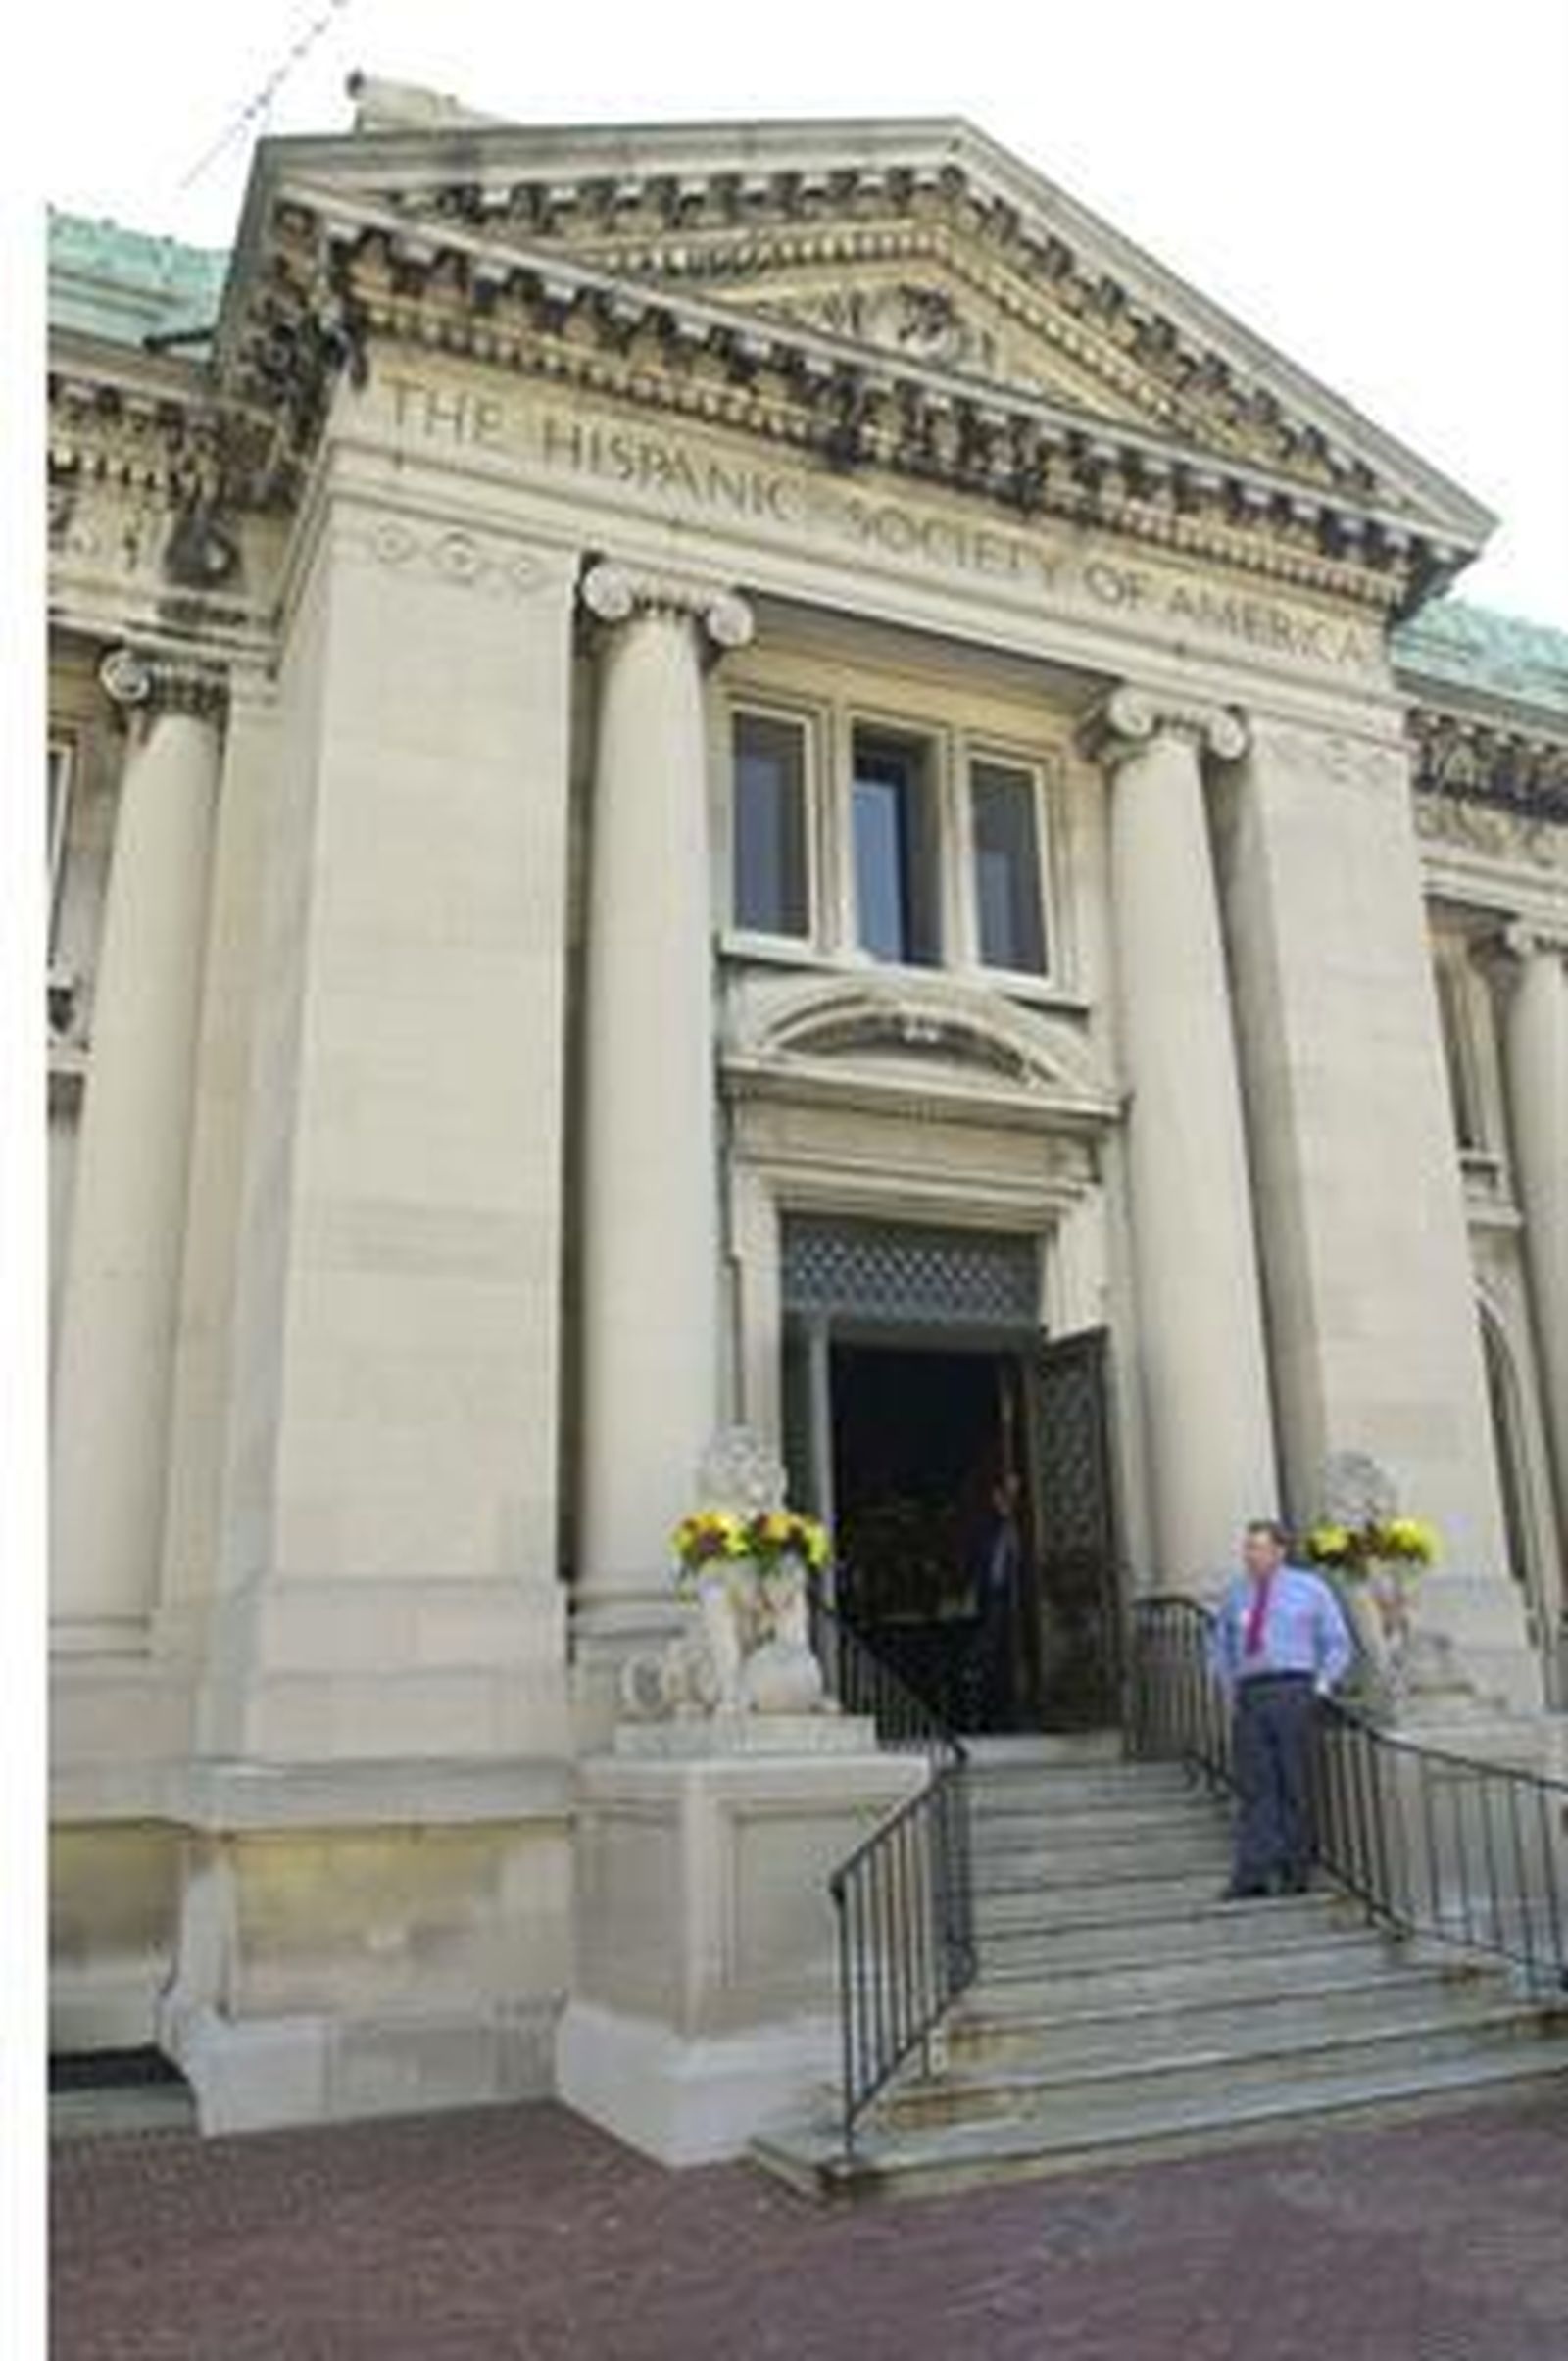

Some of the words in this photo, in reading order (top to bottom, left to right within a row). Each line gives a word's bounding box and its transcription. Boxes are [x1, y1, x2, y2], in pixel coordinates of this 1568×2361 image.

[380, 375, 504, 445] THE
[542, 415, 802, 523] HISPANIC
[844, 497, 1064, 592] SOCIETY
[1082, 560, 1153, 612] OF
